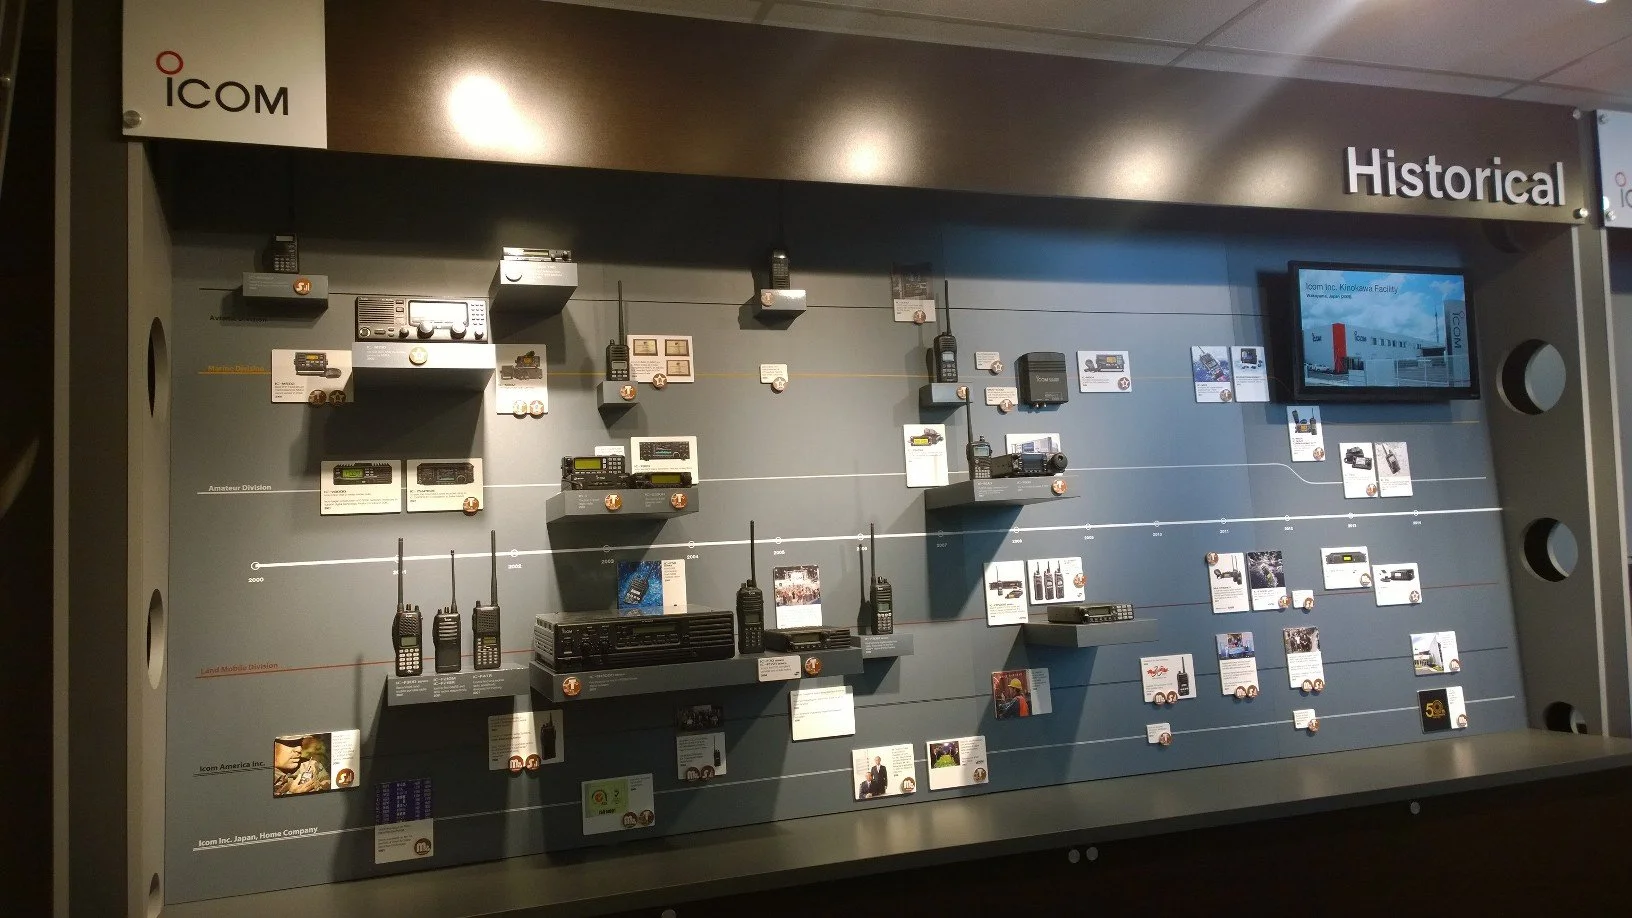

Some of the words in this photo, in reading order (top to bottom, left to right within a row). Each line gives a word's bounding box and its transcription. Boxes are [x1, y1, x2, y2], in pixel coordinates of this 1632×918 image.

[1346, 146, 1566, 206] Historical
[1325, 282, 1338, 291] Inc.
[1339, 283, 1373, 292] Kinokawa
[1374, 284, 1399, 294] Facility
[248, 662, 279, 671] Division
[219, 762, 251, 771] America
[198, 839, 218, 847] Icom
[234, 834, 259, 843] Japan,
[259, 831, 282, 839] Home
[283, 826, 318, 837] Company
